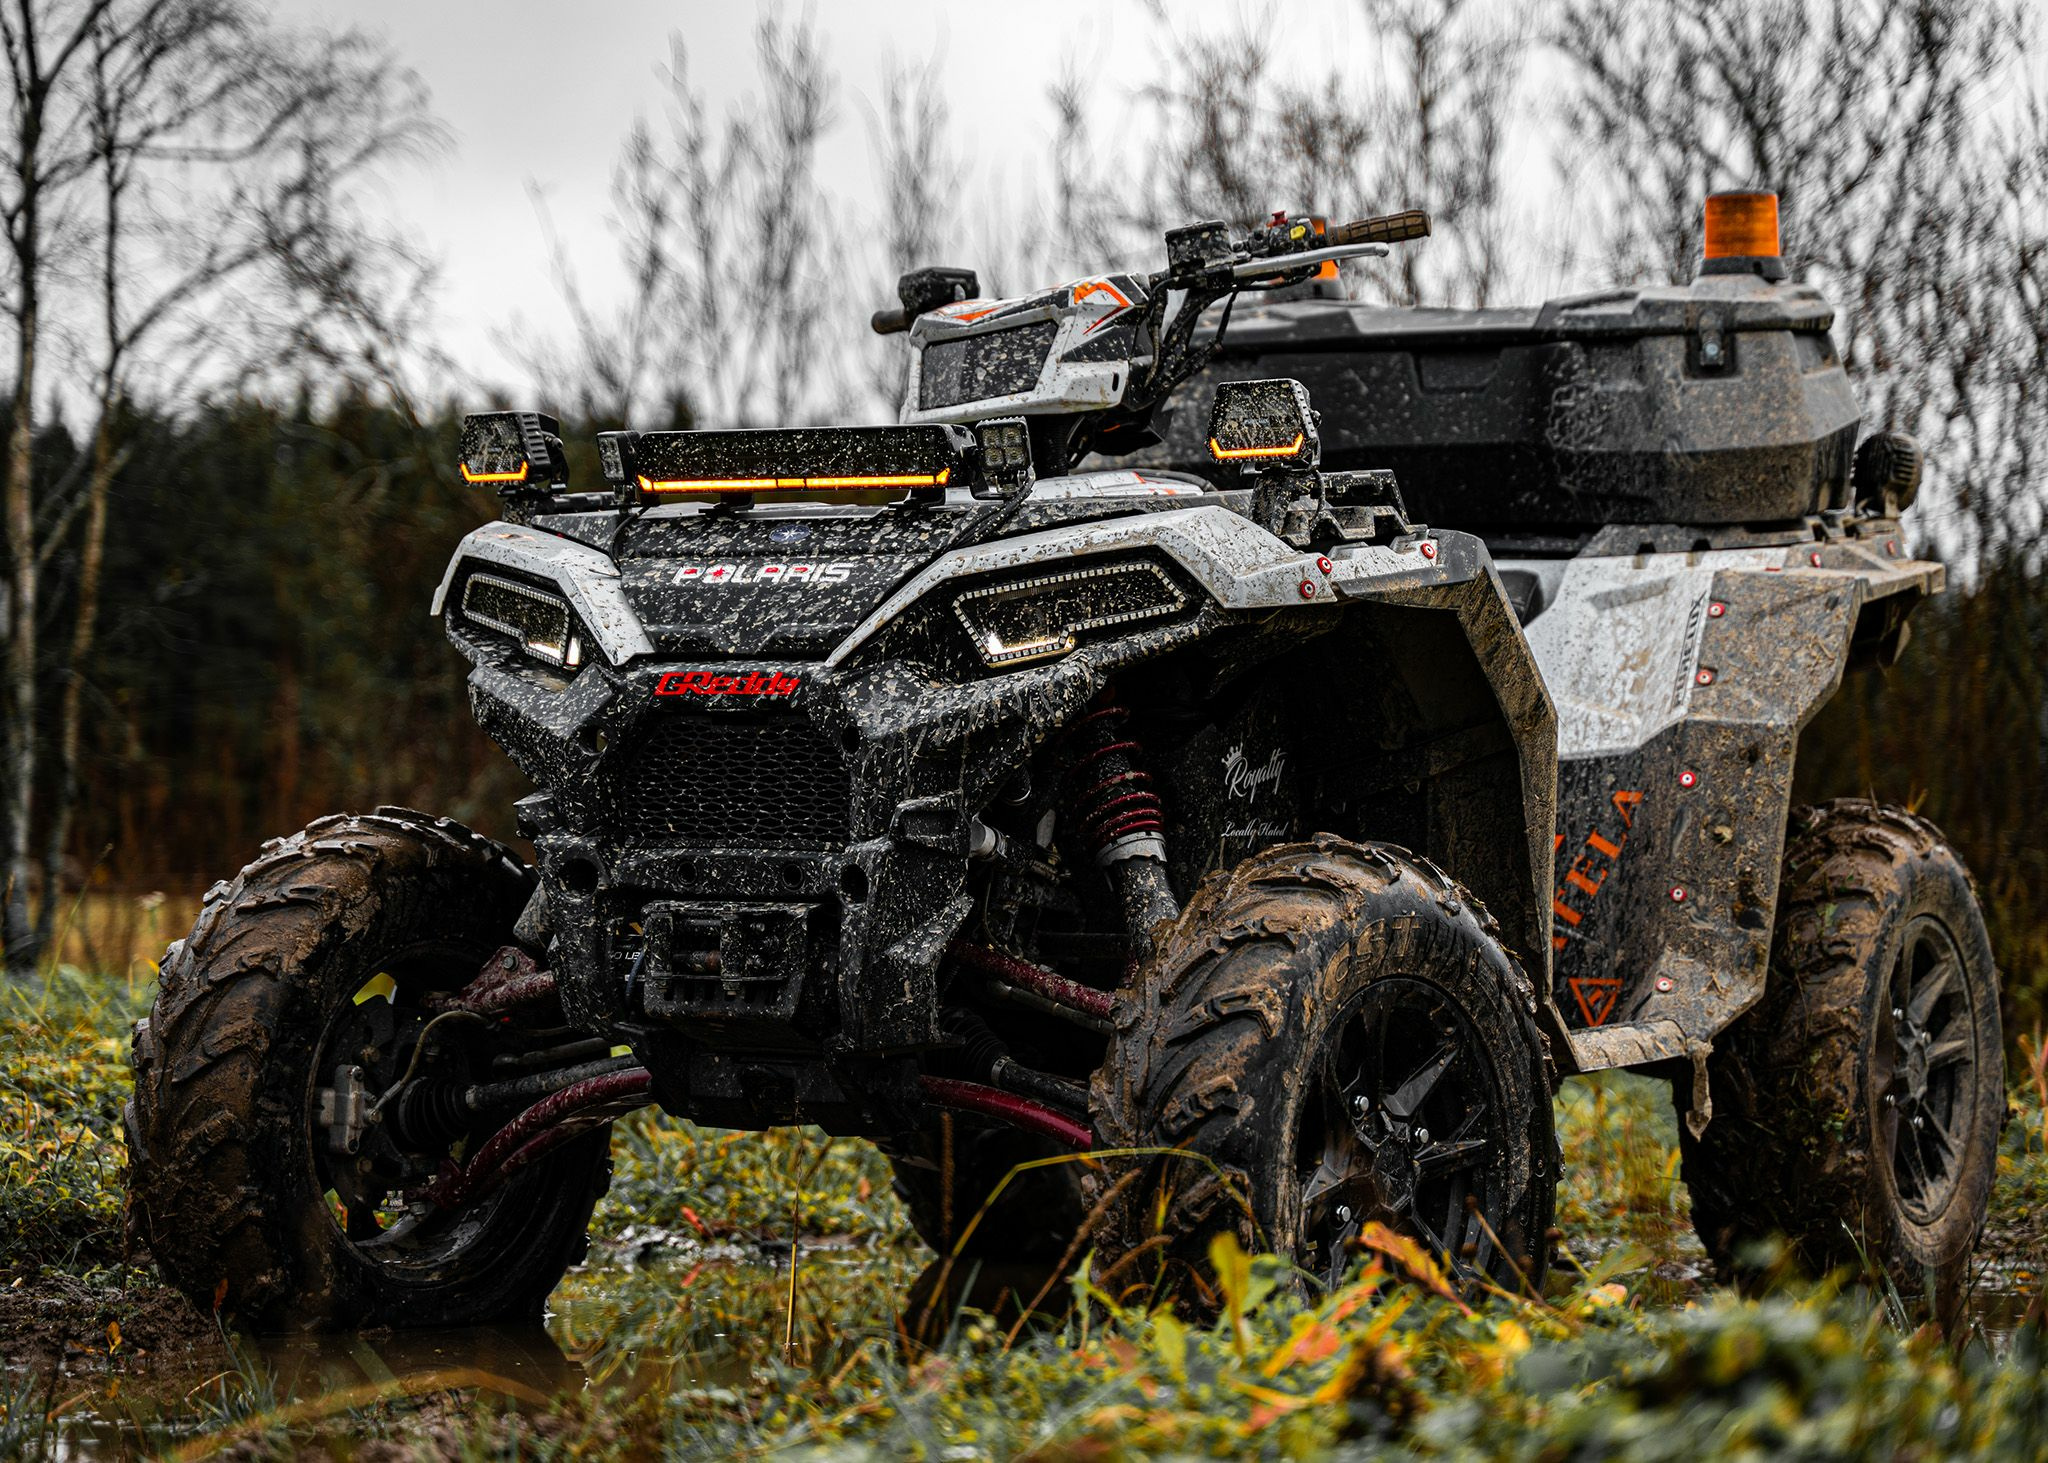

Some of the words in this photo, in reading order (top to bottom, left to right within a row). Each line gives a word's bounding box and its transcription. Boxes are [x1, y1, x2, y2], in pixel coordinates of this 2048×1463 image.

[672, 562, 854, 585] POLARIS
[653, 671, 801, 696] GReddy
[1224, 747, 1288, 804] Royalty
[1220, 817, 1260, 849] Locally
